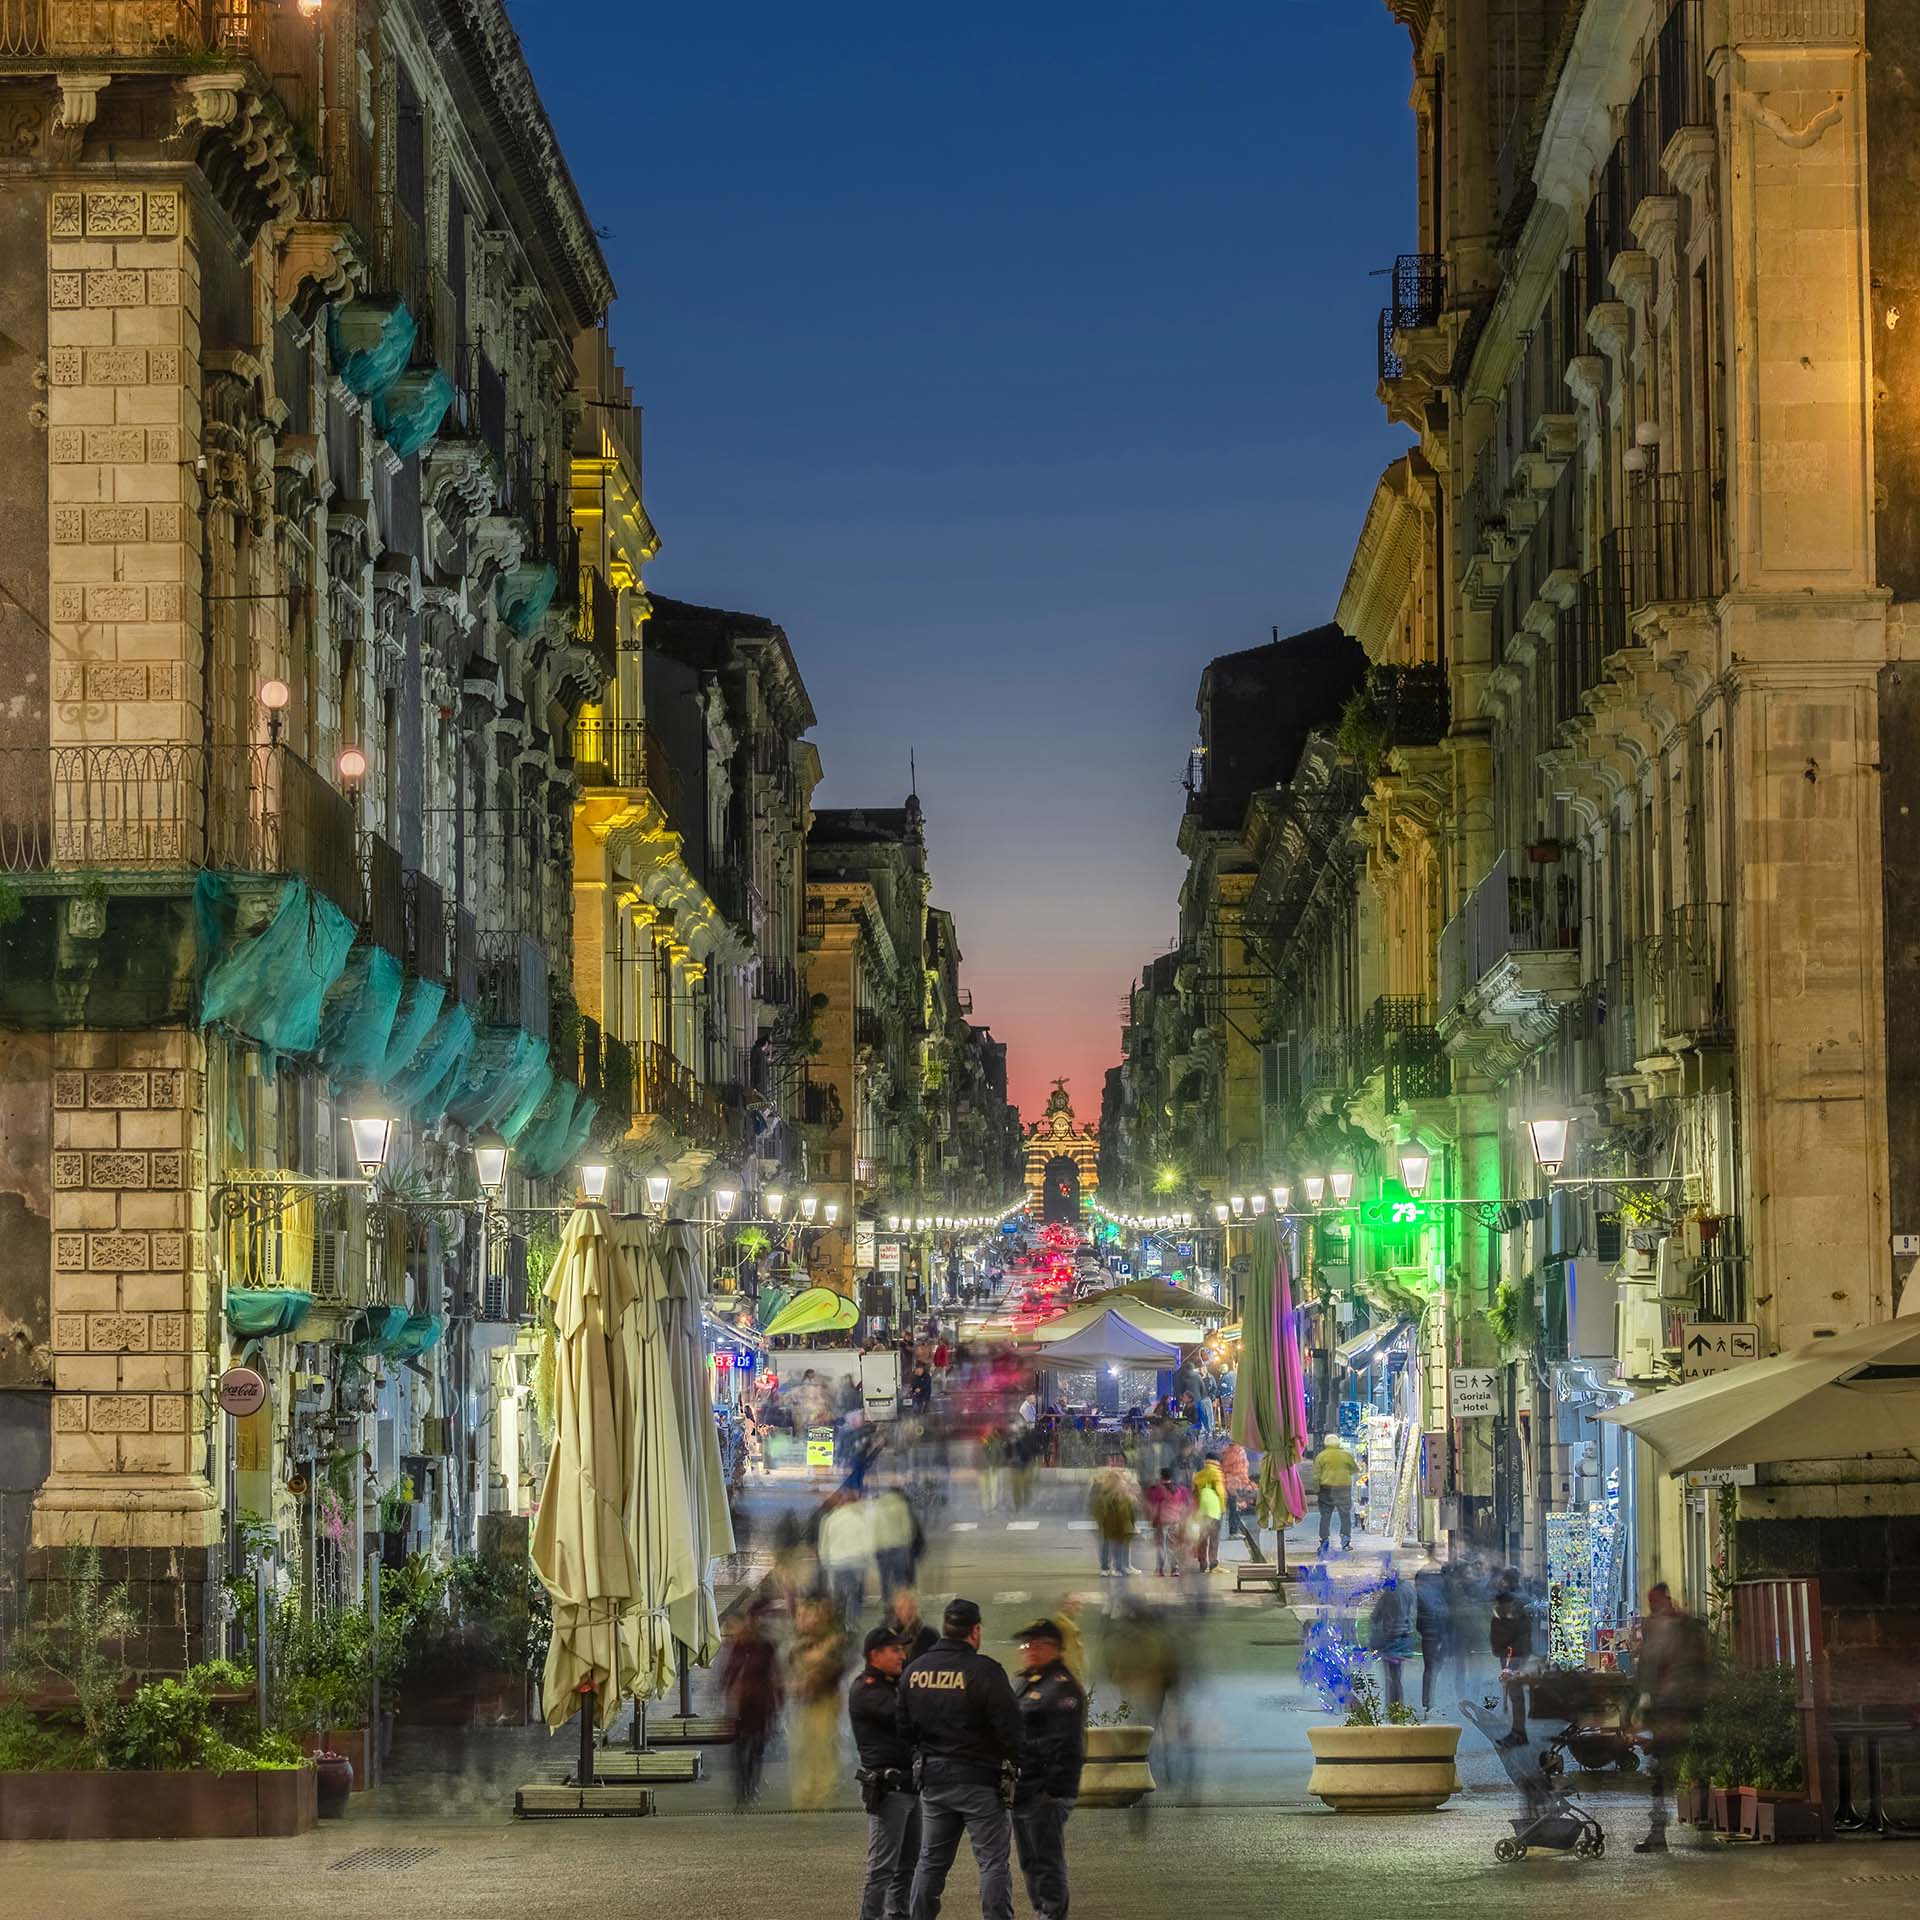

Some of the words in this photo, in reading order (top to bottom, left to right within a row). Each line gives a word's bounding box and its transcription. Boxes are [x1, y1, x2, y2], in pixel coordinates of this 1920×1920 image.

[1904, 1236, 1909, 1249] 9
[1121, 1264, 1129, 1273] P
[1182, 1310, 1225, 1318] TRATTORIA
[1685, 1369, 1699, 1378] LA
[1459, 1392, 1491, 1401] Gorizia
[1463, 1403, 1488, 1411] Hotel
[910, 1671, 965, 1689] POLIZIA
